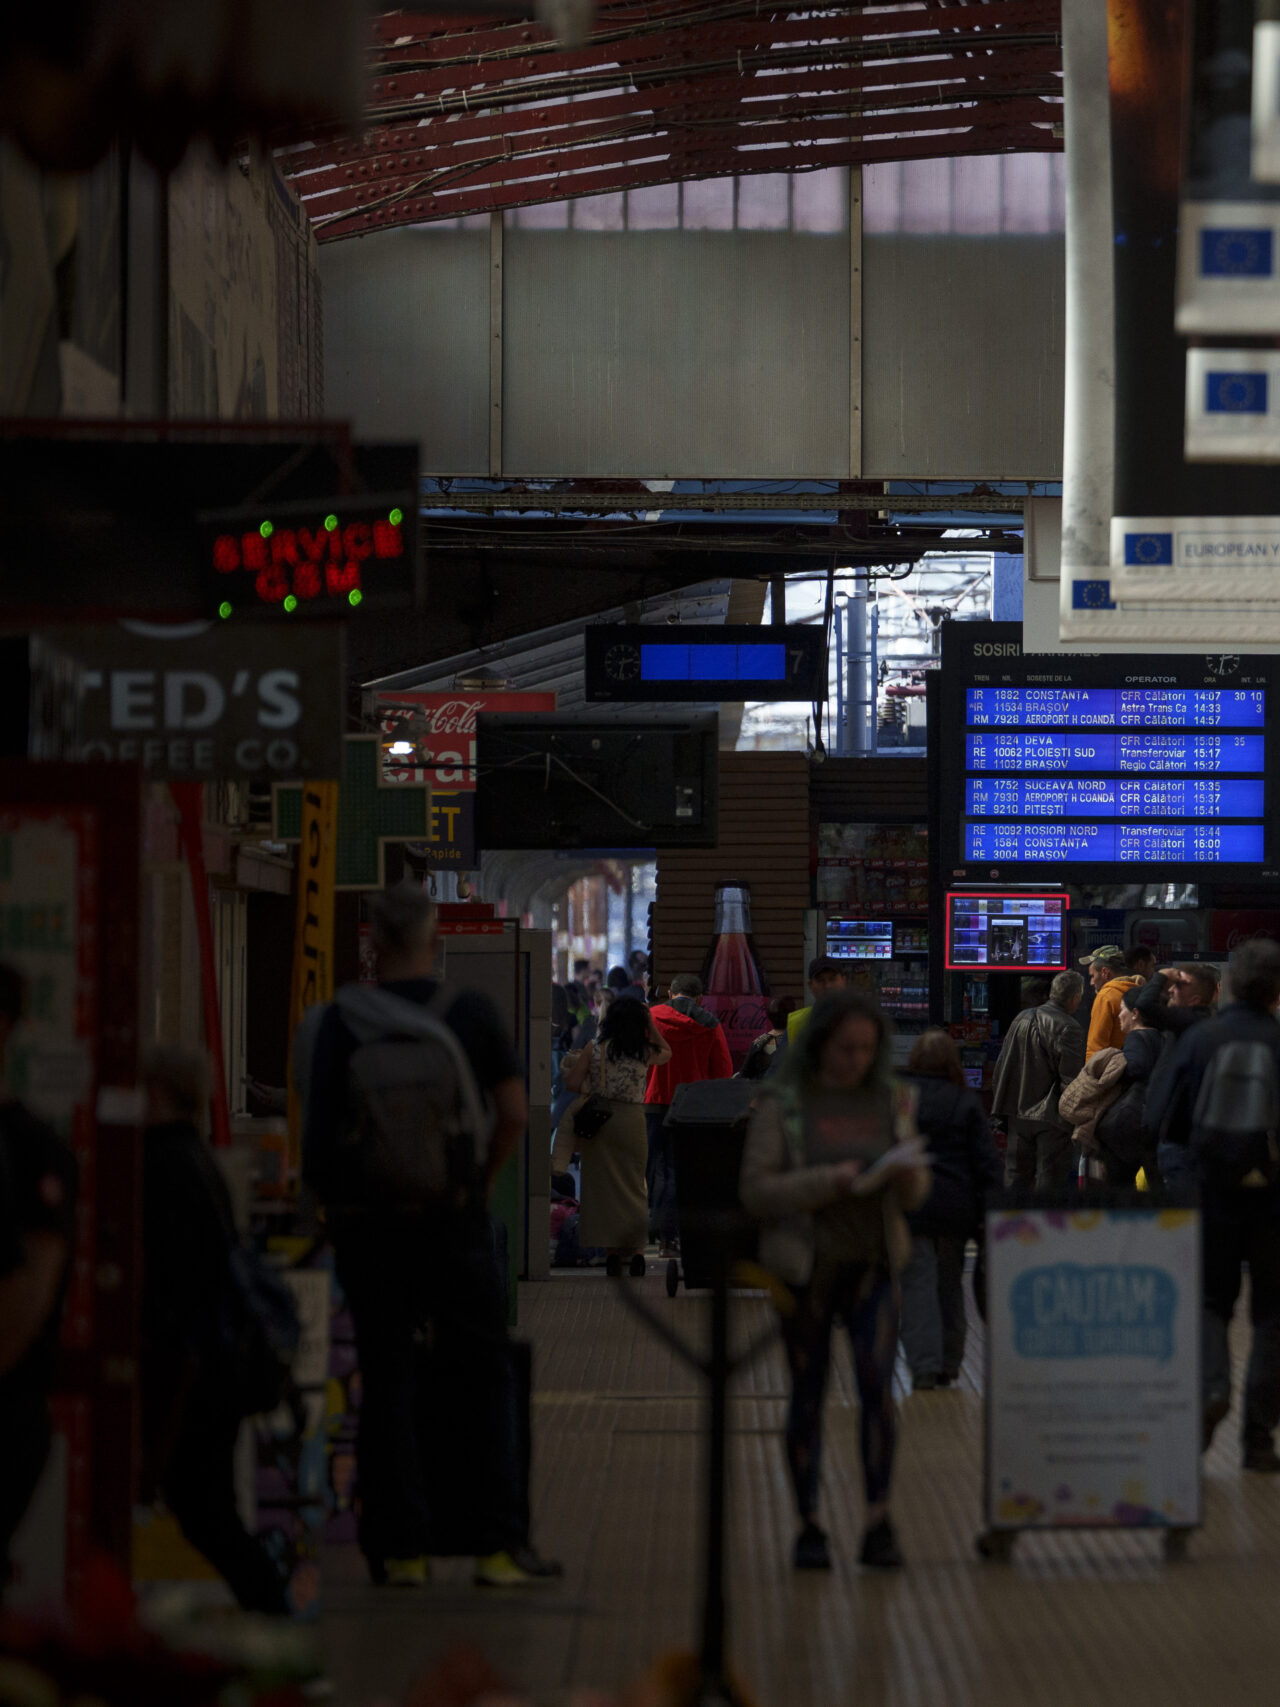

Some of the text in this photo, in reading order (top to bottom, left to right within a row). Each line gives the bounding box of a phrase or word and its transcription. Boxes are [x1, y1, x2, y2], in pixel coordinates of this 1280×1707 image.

[1184, 542, 1268, 557] EUROPEAN
[973, 643, 1020, 657] SOSIRI
[789, 650, 804, 675] 7
[1194, 691, 1221, 701] 14:07
[1121, 703, 1145, 712] Astra
[1148, 703, 1173, 712] Trans
[1194, 703, 1221, 713] 14:33
[1025, 714, 1069, 724] AEROPORT
[1194, 715, 1221, 725] 14:57
[1025, 736, 1053, 745] DEVA
[81, 738, 312, 772] OFFEE CO.
[994, 747, 1022, 757] 10062
[1074, 748, 1095, 757] SUD
[1120, 748, 1186, 758] Transferoviar
[1194, 748, 1221, 758] 15:17
[994, 759, 1022, 769] 11032
[1120, 760, 1146, 771] Regio
[1194, 760, 1221, 770] 15:27
[994, 780, 1220, 791] 1752 SUCEAVA NORD 15:35
[994, 792, 1019, 802] 7930
[1025, 792, 1068, 802] AEROPORT
[1194, 793, 1221, 803] 15:37
[993, 804, 1018, 814] 9210
[1194, 805, 1220, 815] 15:41
[994, 825, 1022, 835] 10092
[1070, 826, 1098, 836] NORD
[1120, 826, 1185, 836] Transferoviar
[1194, 827, 1220, 837] 15:44
[1194, 839, 1220, 849] 16:00
[993, 849, 1018, 859] 3004
